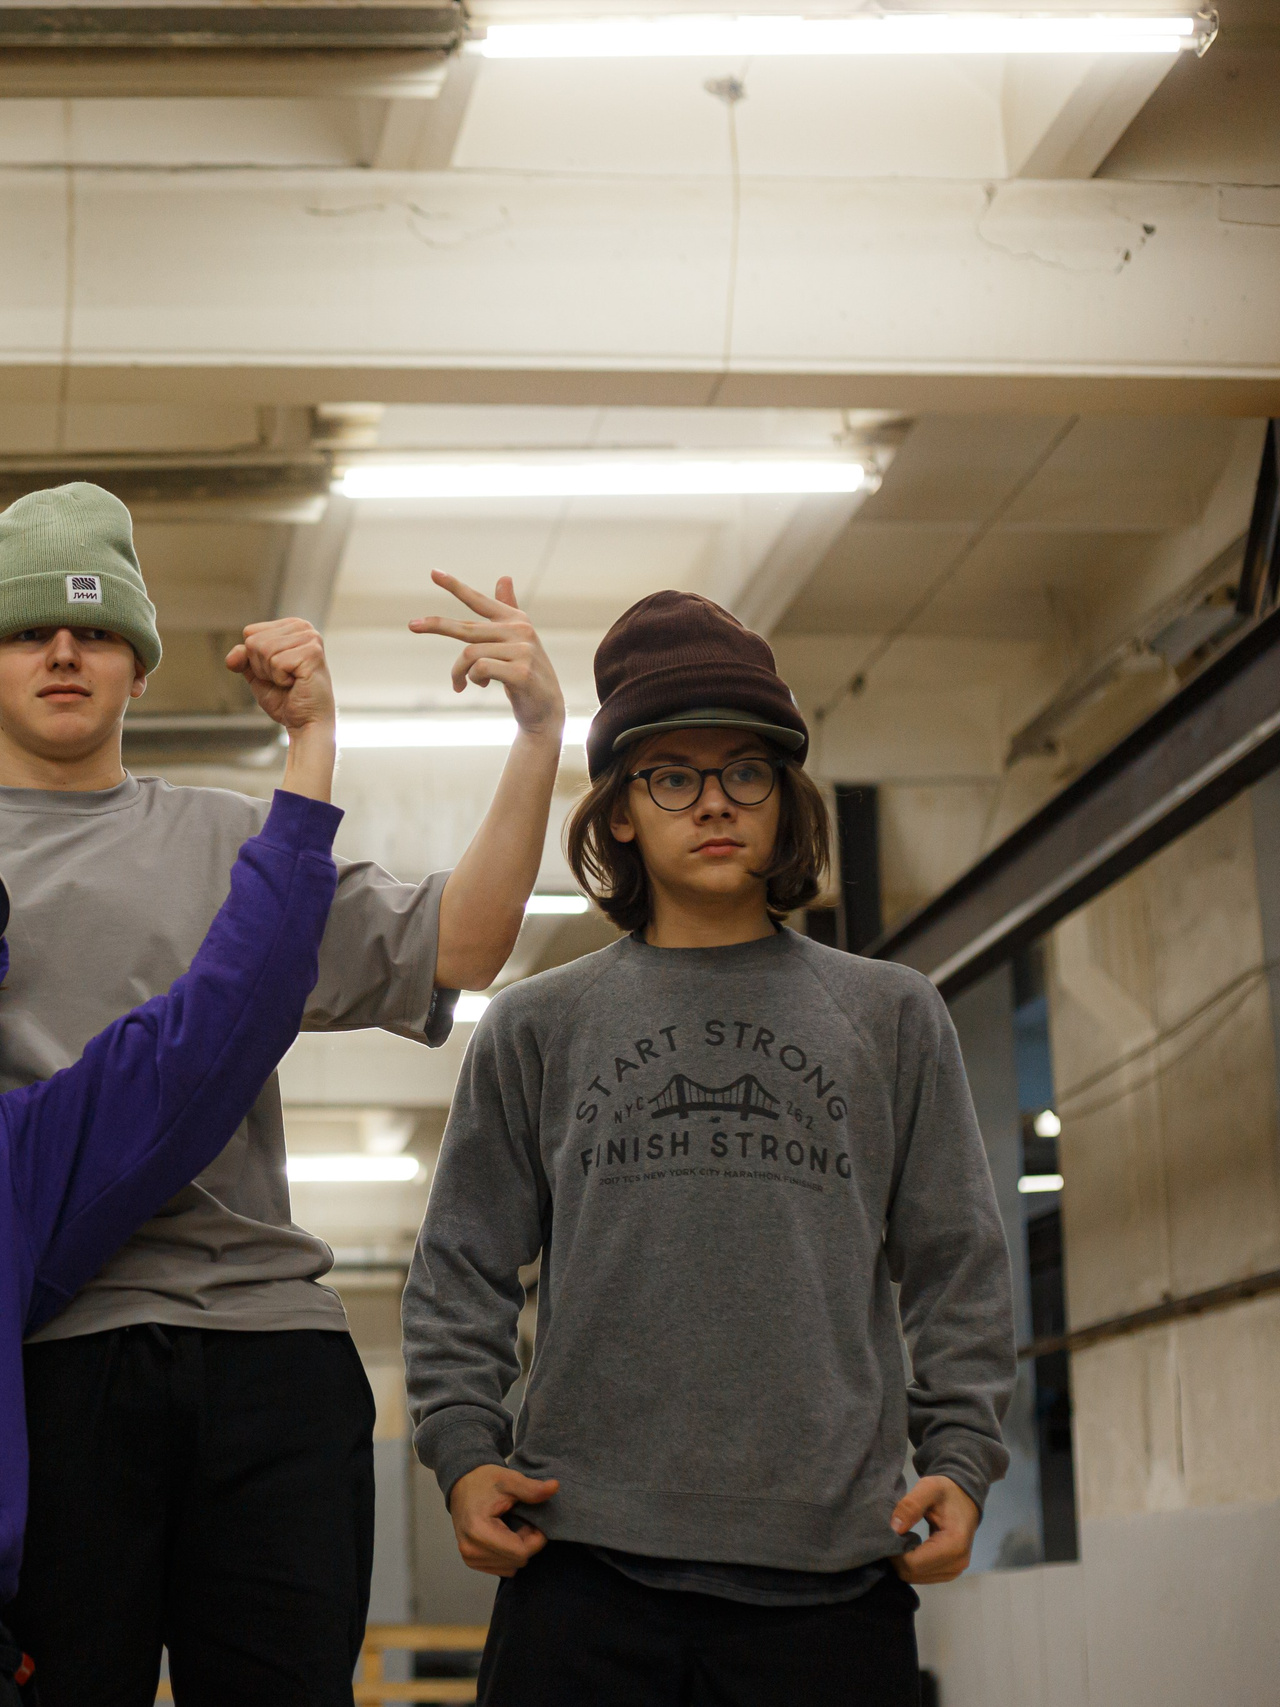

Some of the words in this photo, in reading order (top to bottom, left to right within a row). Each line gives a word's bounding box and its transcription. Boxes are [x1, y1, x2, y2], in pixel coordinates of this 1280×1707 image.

[576, 1025, 678, 1124] START
[704, 1019, 847, 1122] STRONG
[614, 1096, 644, 1124] NYC
[580, 1130, 689, 1176] FINISH
[710, 1131, 852, 1179] STRONG
[599, 1176, 620, 1186] 2017
[622, 1174, 640, 1184] TCS
[643, 1171, 666, 1181] NEW
[669, 1167, 697, 1177] YORK
[699, 1167, 720, 1177] CITY
[723, 1170, 781, 1181] MARATHON
[783, 1175, 824, 1192] FINISHER
